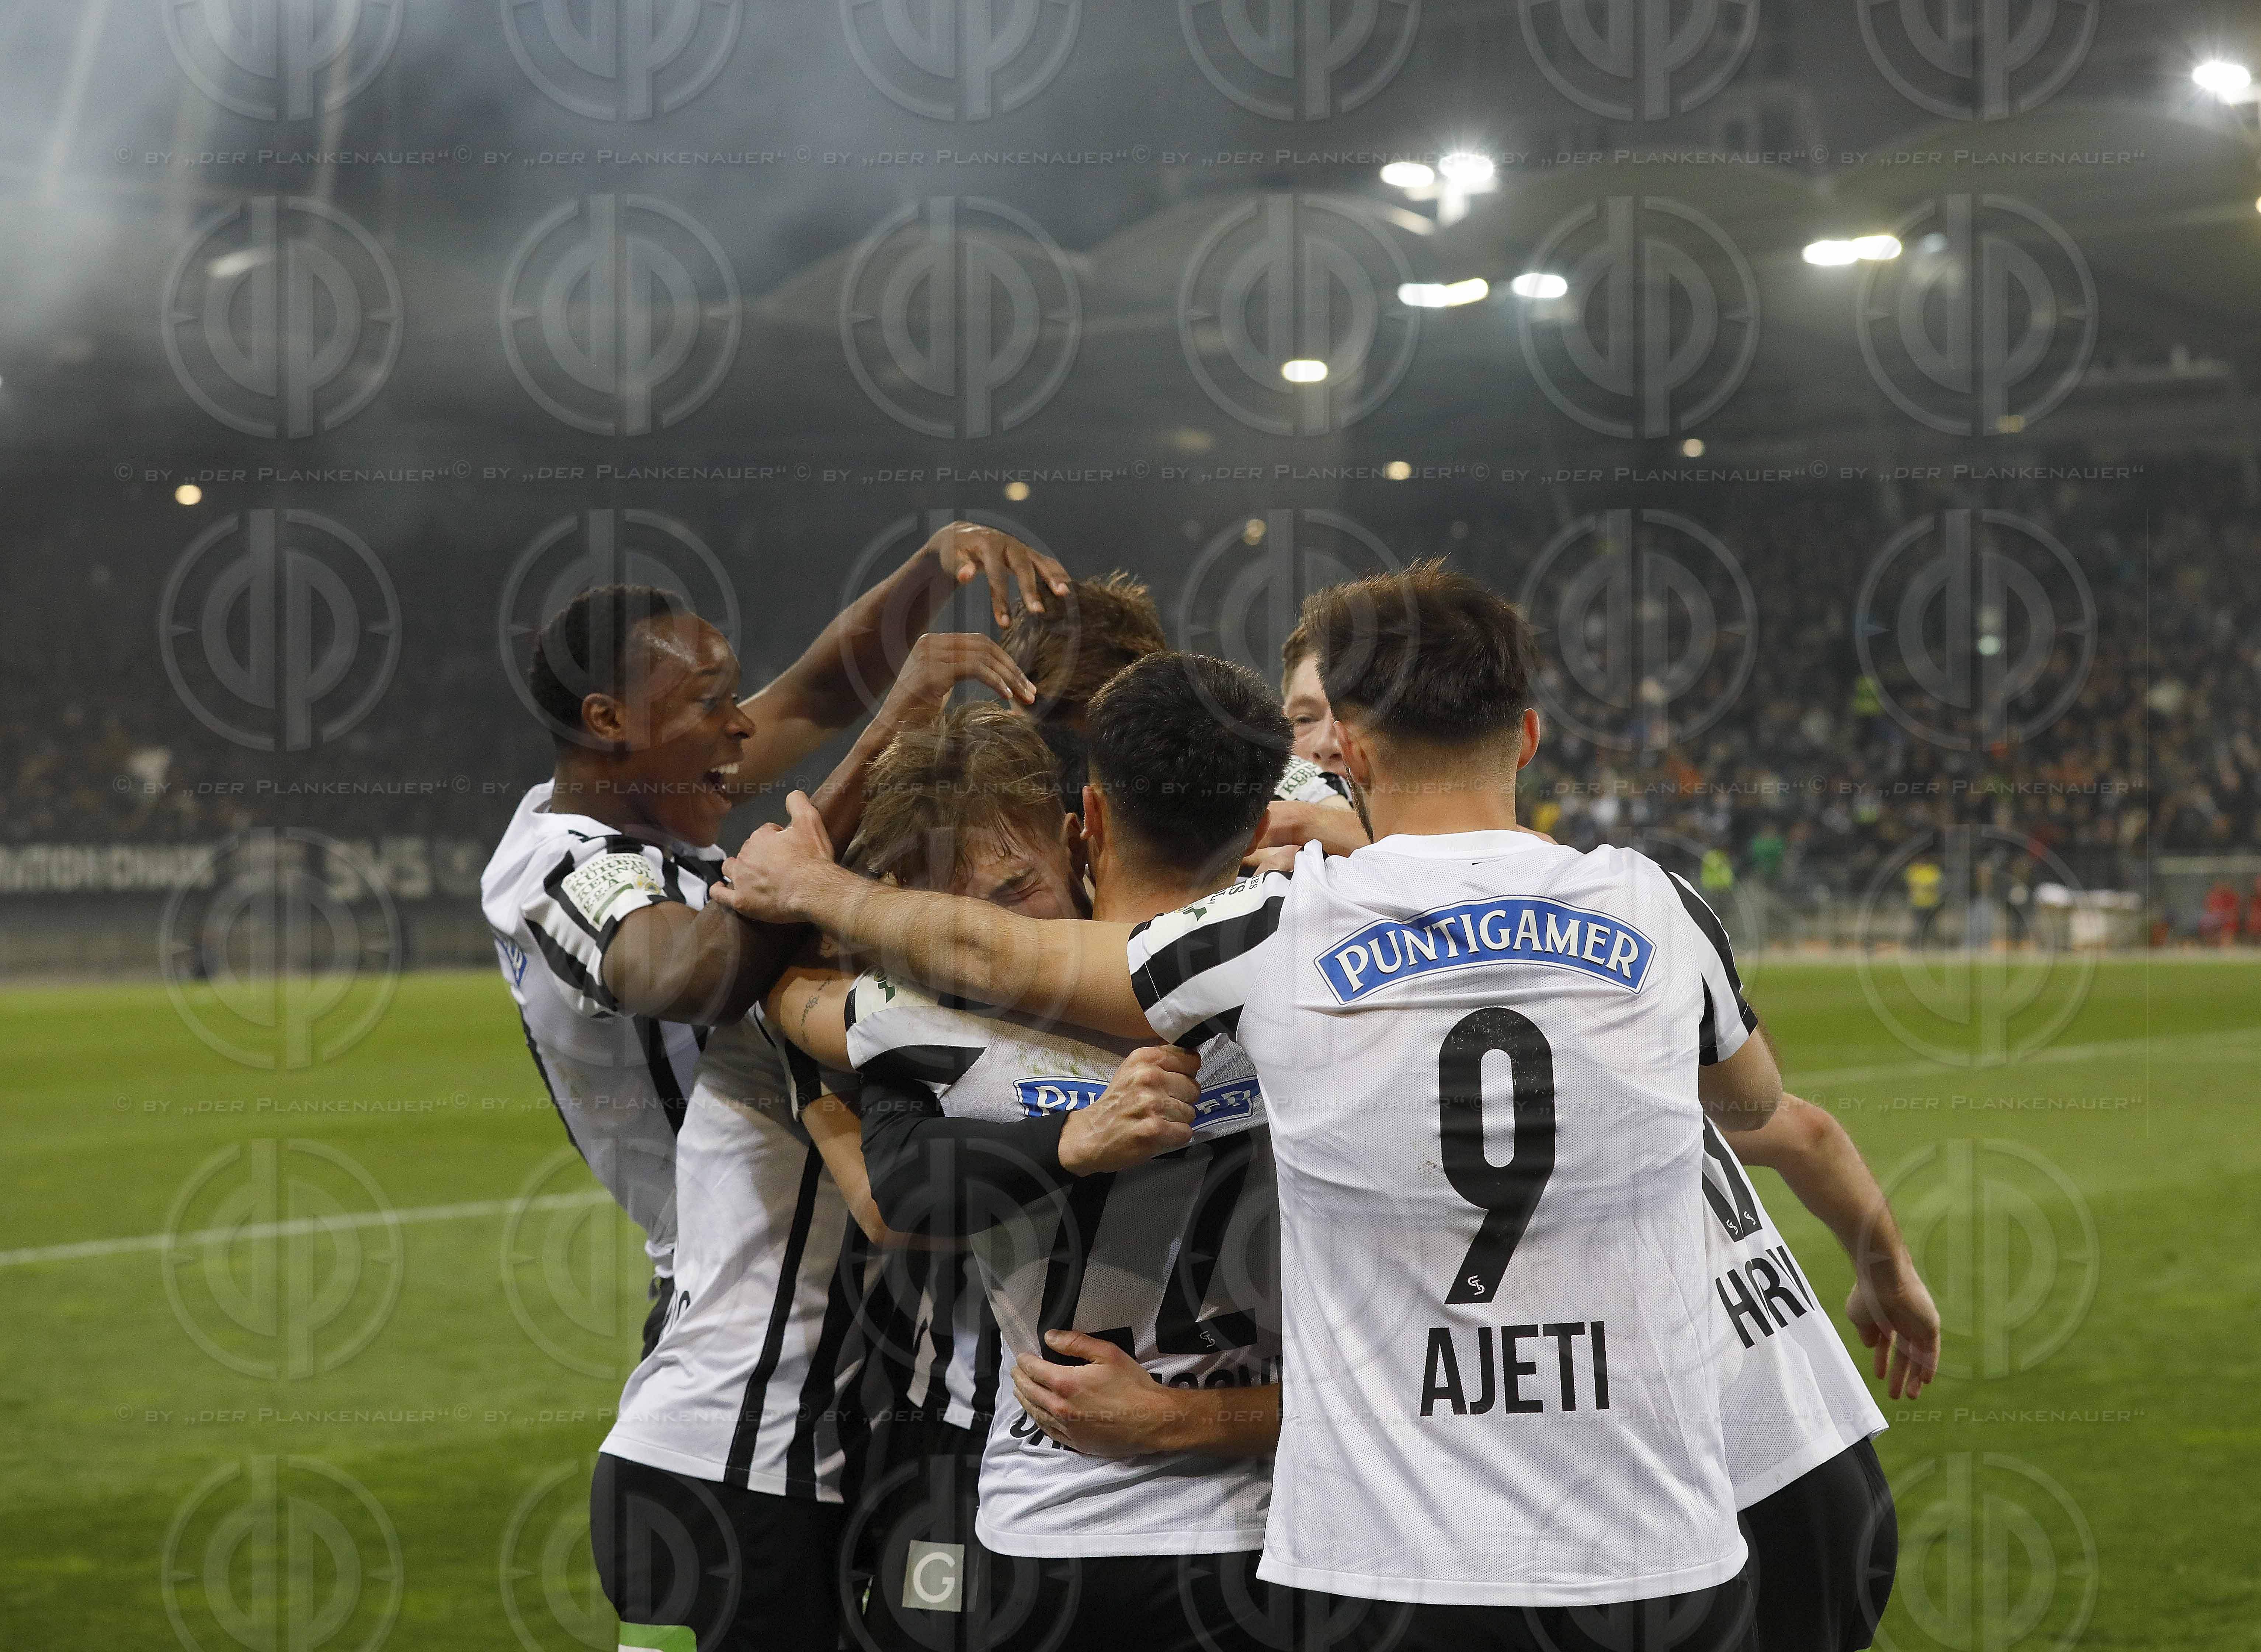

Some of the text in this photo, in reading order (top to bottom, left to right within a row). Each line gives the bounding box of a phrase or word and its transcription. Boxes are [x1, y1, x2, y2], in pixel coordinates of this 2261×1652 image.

[1335, 909, 1639, 993] PUNTIGAMER
[1438, 1007, 1555, 1304] 9
[1420, 1321, 1609, 1416] AJETI
